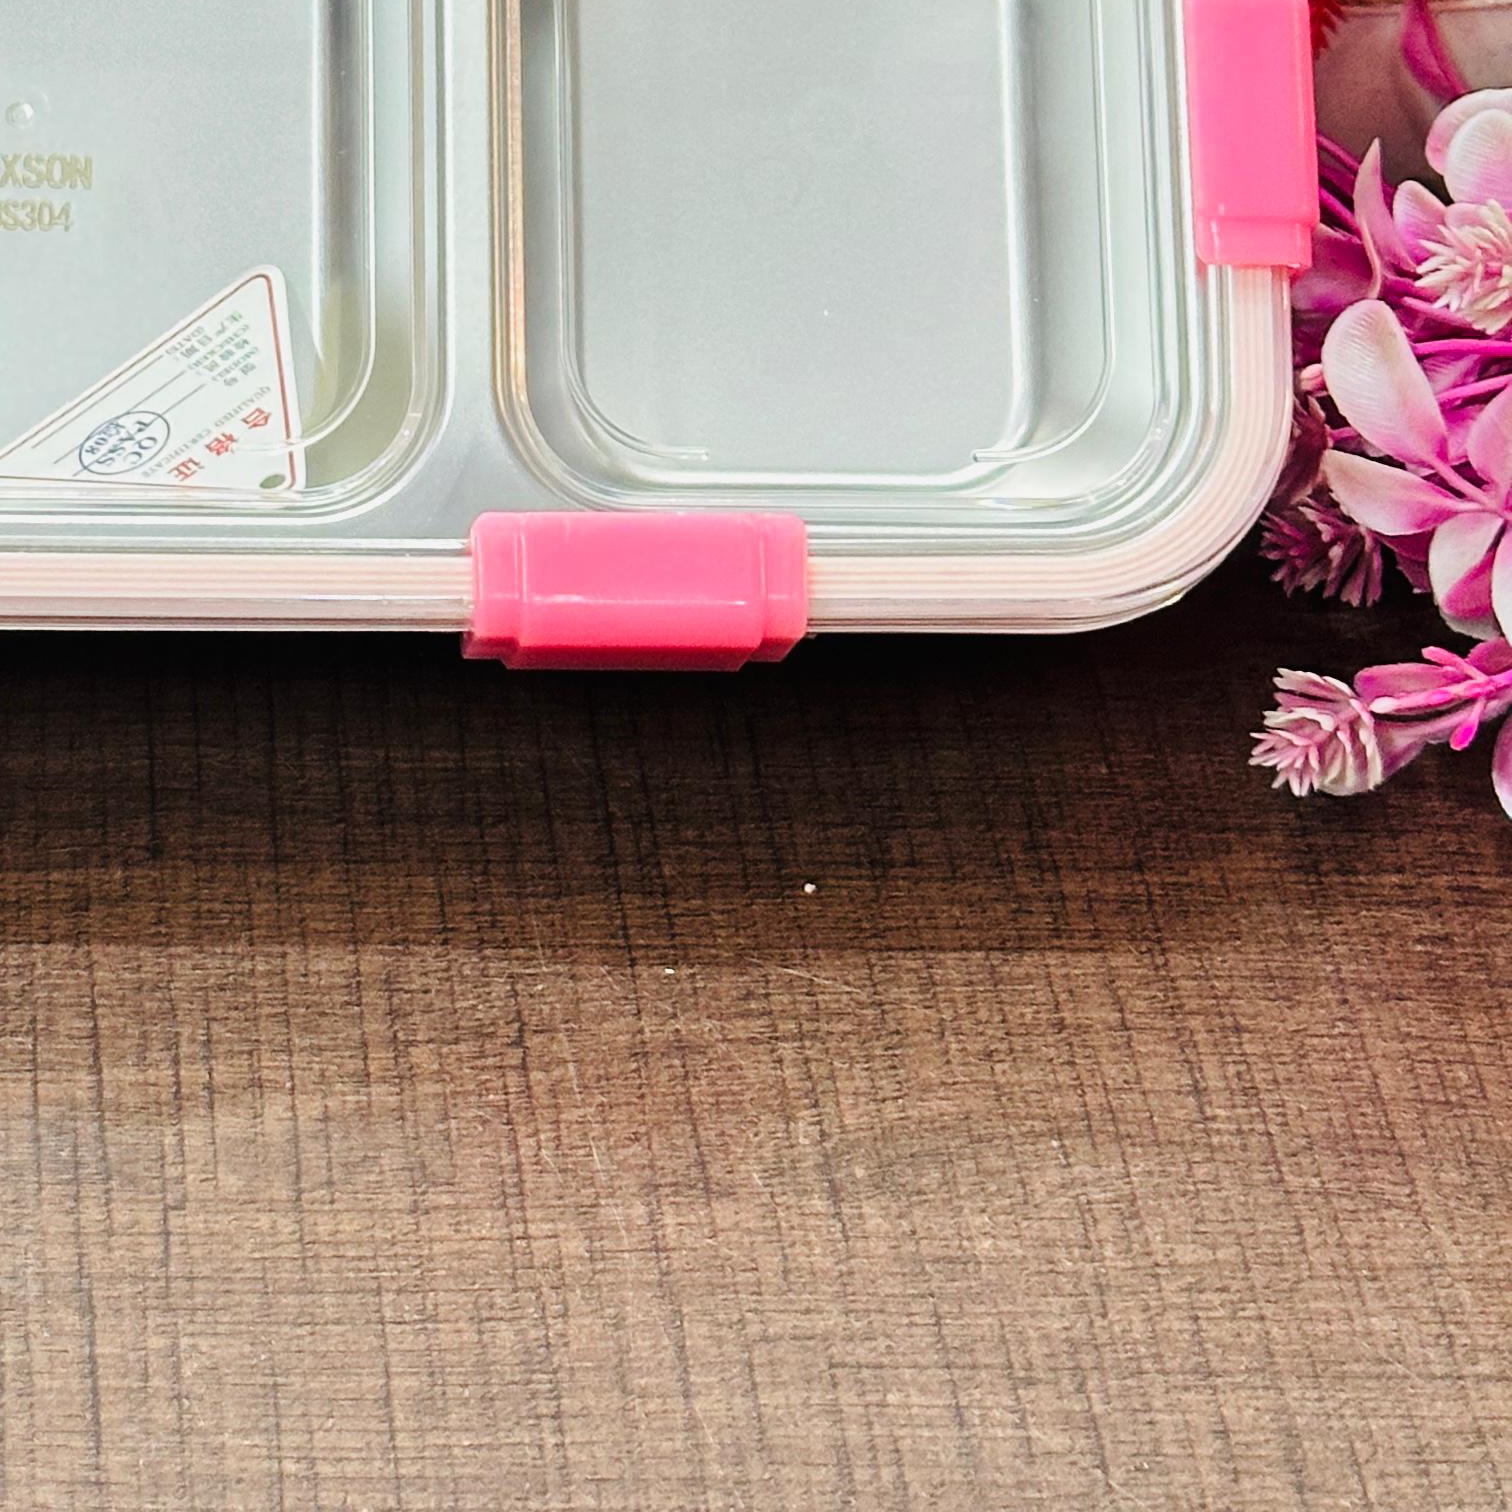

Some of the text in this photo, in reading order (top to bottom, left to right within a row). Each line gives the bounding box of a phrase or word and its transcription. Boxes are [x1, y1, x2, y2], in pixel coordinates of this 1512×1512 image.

[214, 386, 271, 428] QUALIFIED
[94, 419, 148, 467] PASS
[123, 435, 158, 466] QC
[166, 407, 272, 482] 合格证
